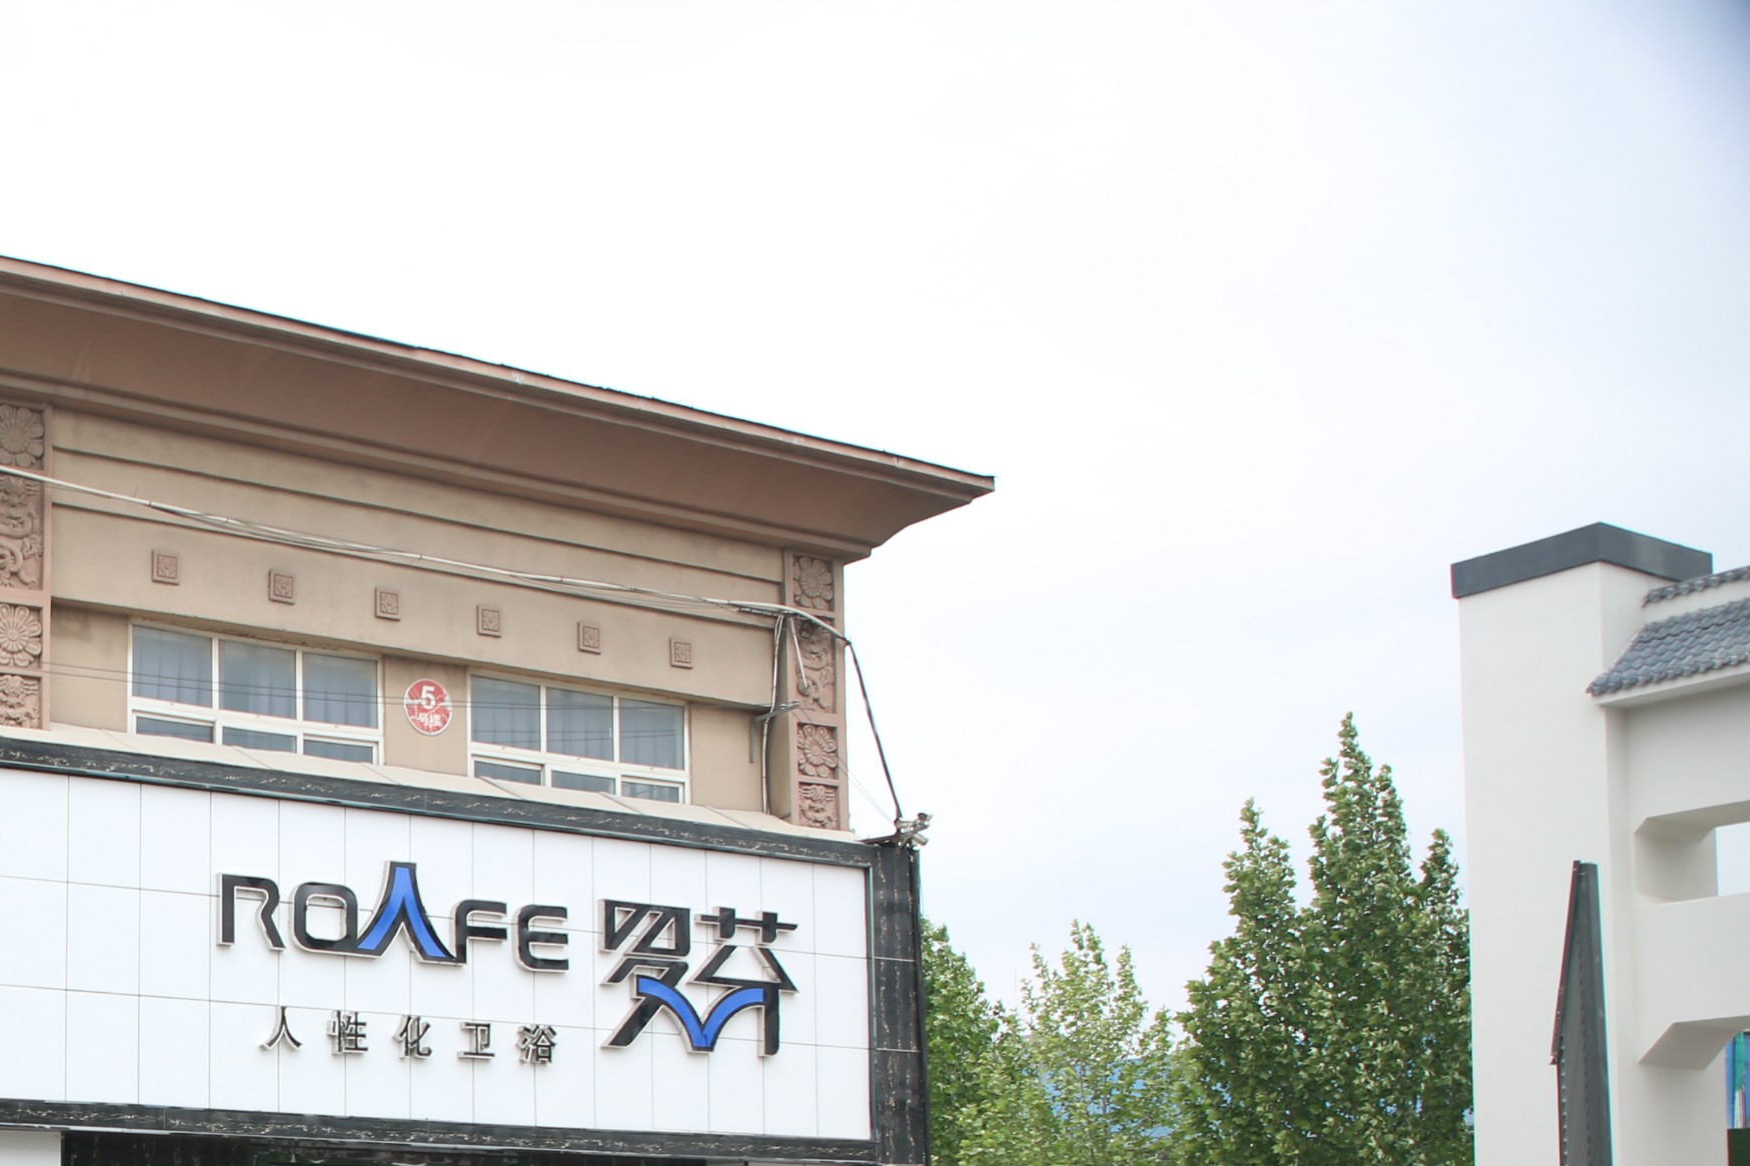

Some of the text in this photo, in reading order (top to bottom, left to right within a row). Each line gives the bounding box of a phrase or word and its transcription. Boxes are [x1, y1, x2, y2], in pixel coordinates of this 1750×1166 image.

[420, 685, 436, 710] 5
[259, 1004, 558, 1065] 人性化卫浴
